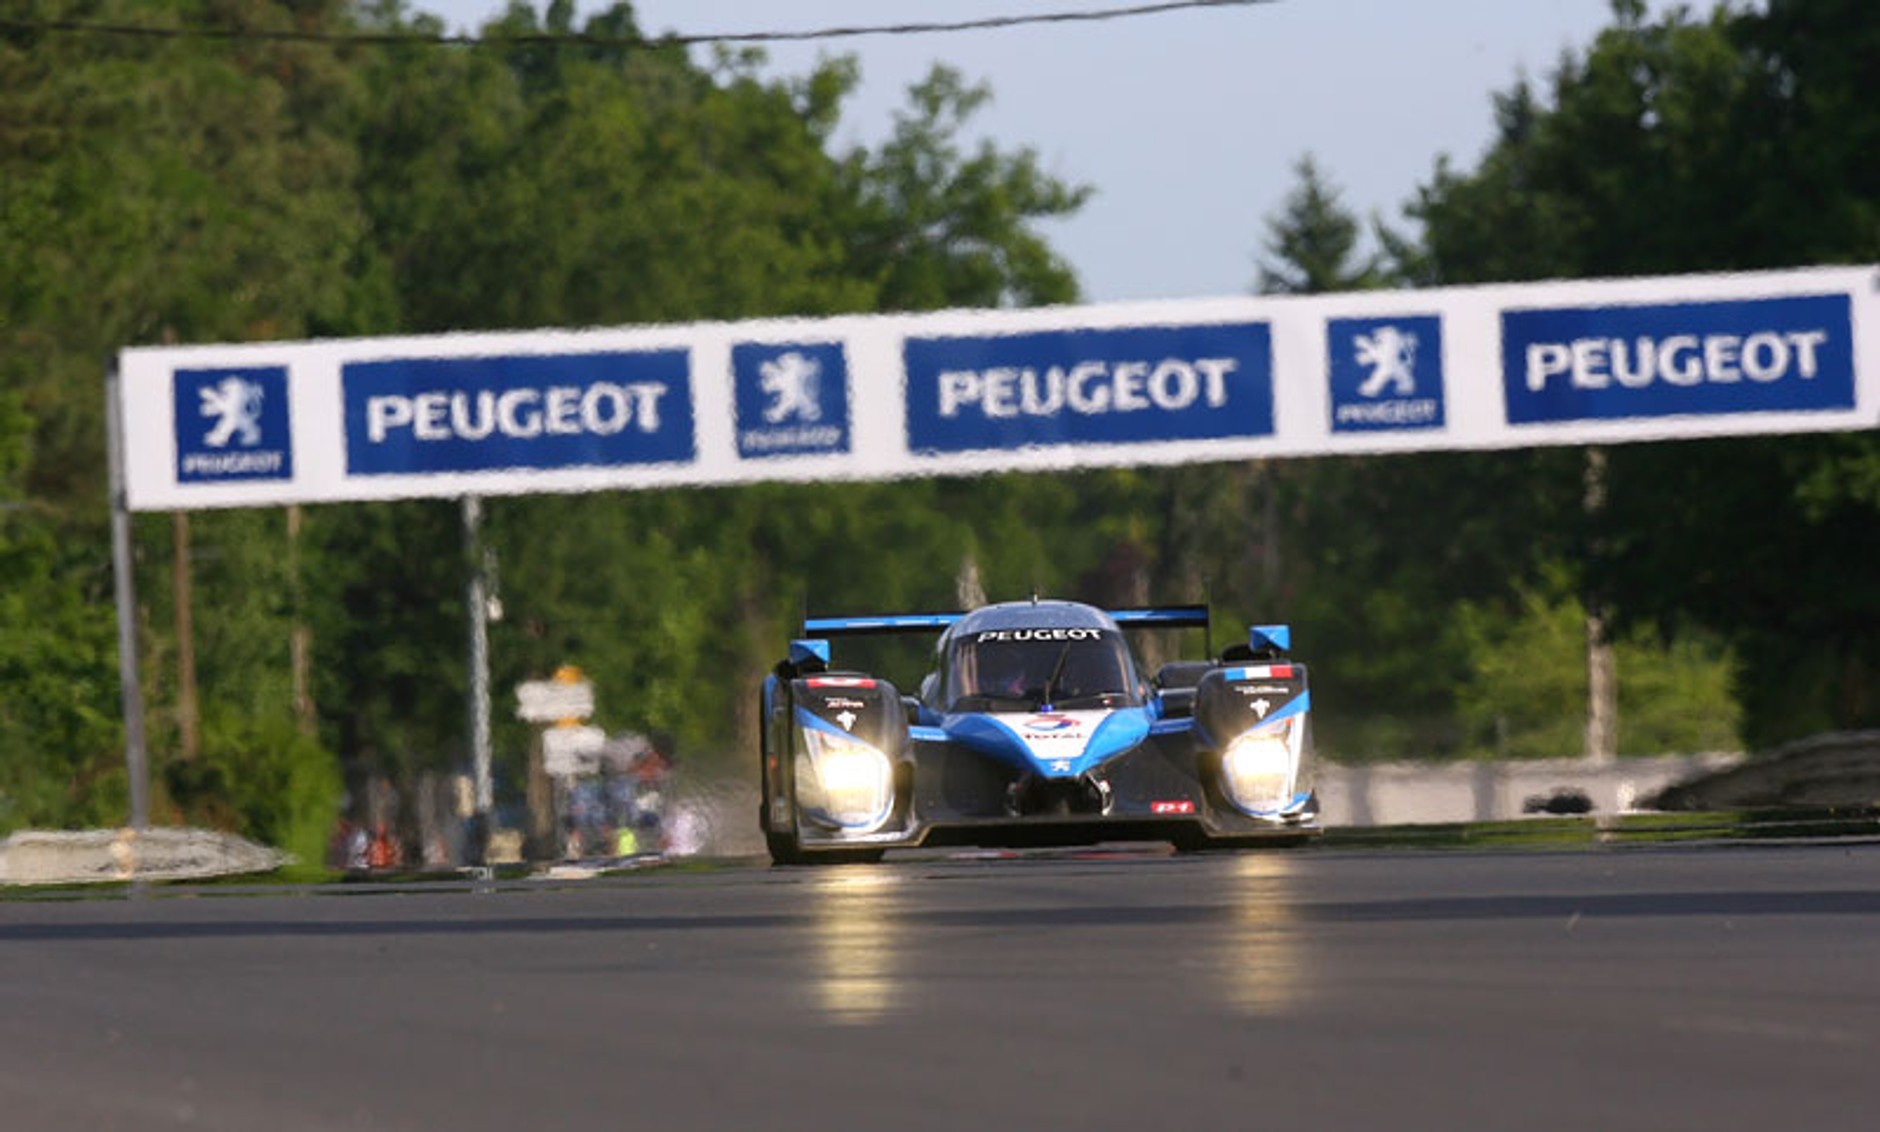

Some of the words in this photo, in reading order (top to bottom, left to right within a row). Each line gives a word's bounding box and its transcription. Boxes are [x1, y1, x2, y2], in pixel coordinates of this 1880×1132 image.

[938, 358, 1237, 416] PEUGEOT
[1526, 331, 1825, 391] PEUGEOT
[367, 381, 666, 442] PEUGEOT
[978, 629, 1101, 642] PEUGEOT
